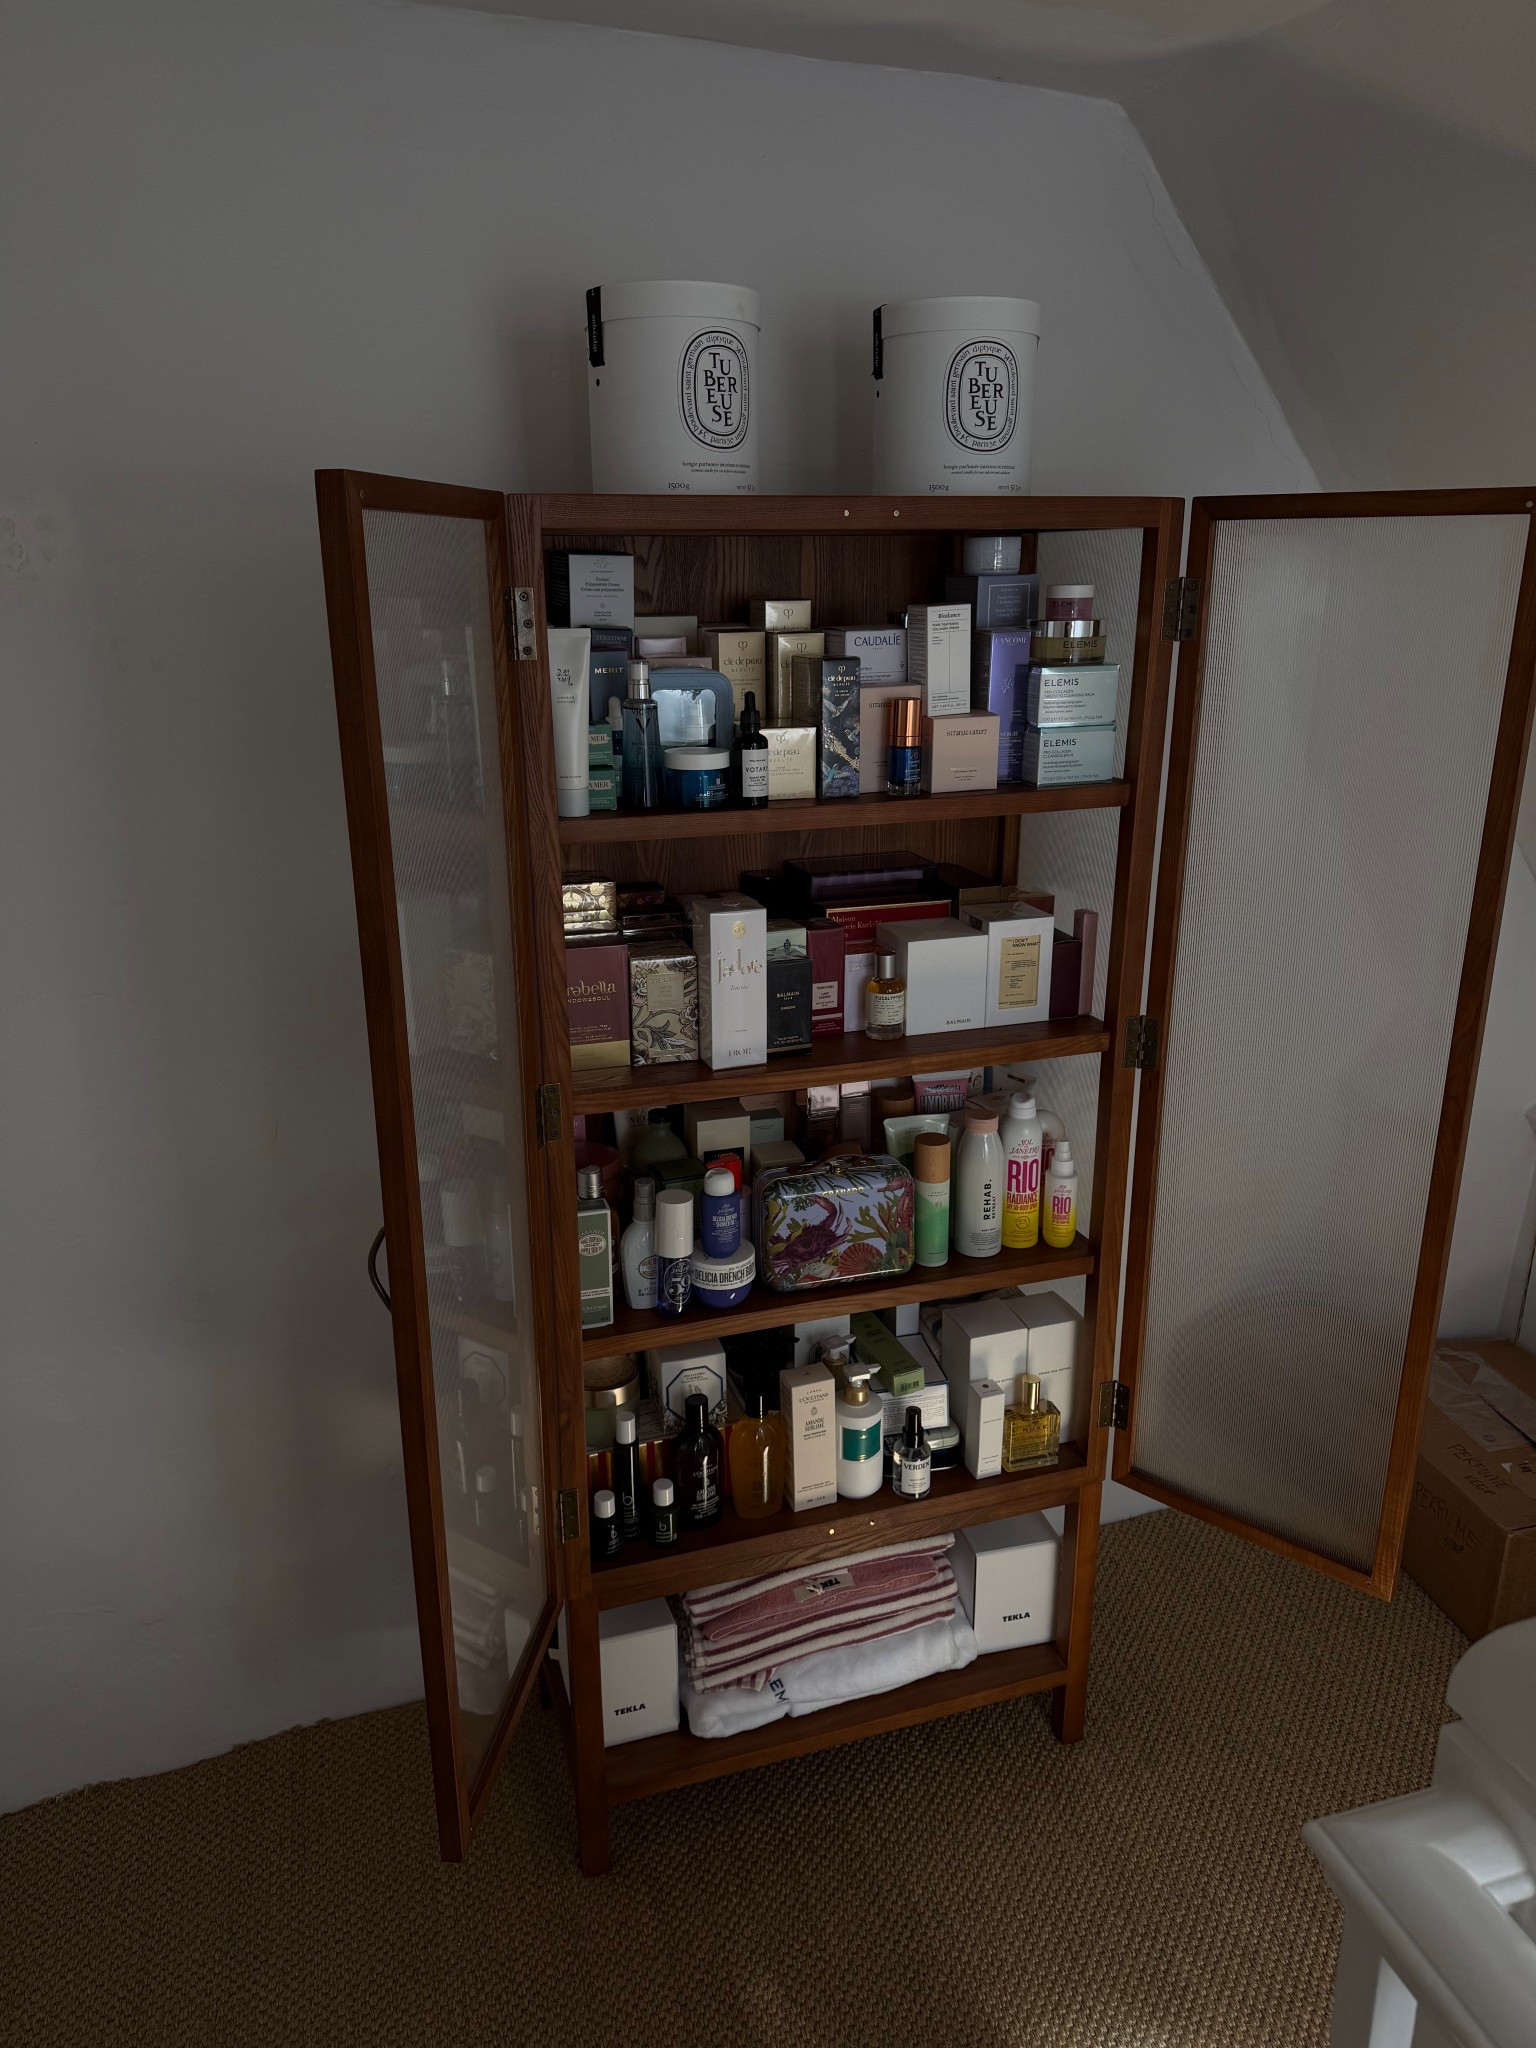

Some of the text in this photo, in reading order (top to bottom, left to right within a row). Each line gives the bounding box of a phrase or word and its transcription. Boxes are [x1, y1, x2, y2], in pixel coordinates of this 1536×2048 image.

[706, 334, 734, 346] diptyque
[686, 339, 704, 370] germain
[972, 345, 1002, 355] diptyque
[953, 350, 971, 379] germain
[1052, 600, 1079, 608] ELEMIS
[1063, 639, 1098, 649] ELEMIS
[594, 666, 624, 674] MERIT
[1044, 678, 1079, 687] ELEMIS
[1043, 738, 1077, 748] ELEMIS
[831, 915, 856, 924] Maison
[776, 990, 800, 999] BALMAIN
[946, 1018, 972, 1026] BALMAIN
[728, 1046, 752, 1057] DIOR
[1007, 1158, 1040, 1194] RIO
[983, 1179, 993, 1221] REHAB.
[1006, 1191, 1039, 1205] RADIANCE
[1052, 1195, 1072, 1215] RIO
[694, 1267, 746, 1284] DELICIA DRENCH
[798, 1392, 829, 1403] L'OCCITANE
[805, 1416, 825, 1427] AMANDE
[1446, 1443, 1510, 1490] PERFUME
[1002, 1611, 1031, 1624] TEKLA
[614, 1702, 647, 1717] TEKLA
